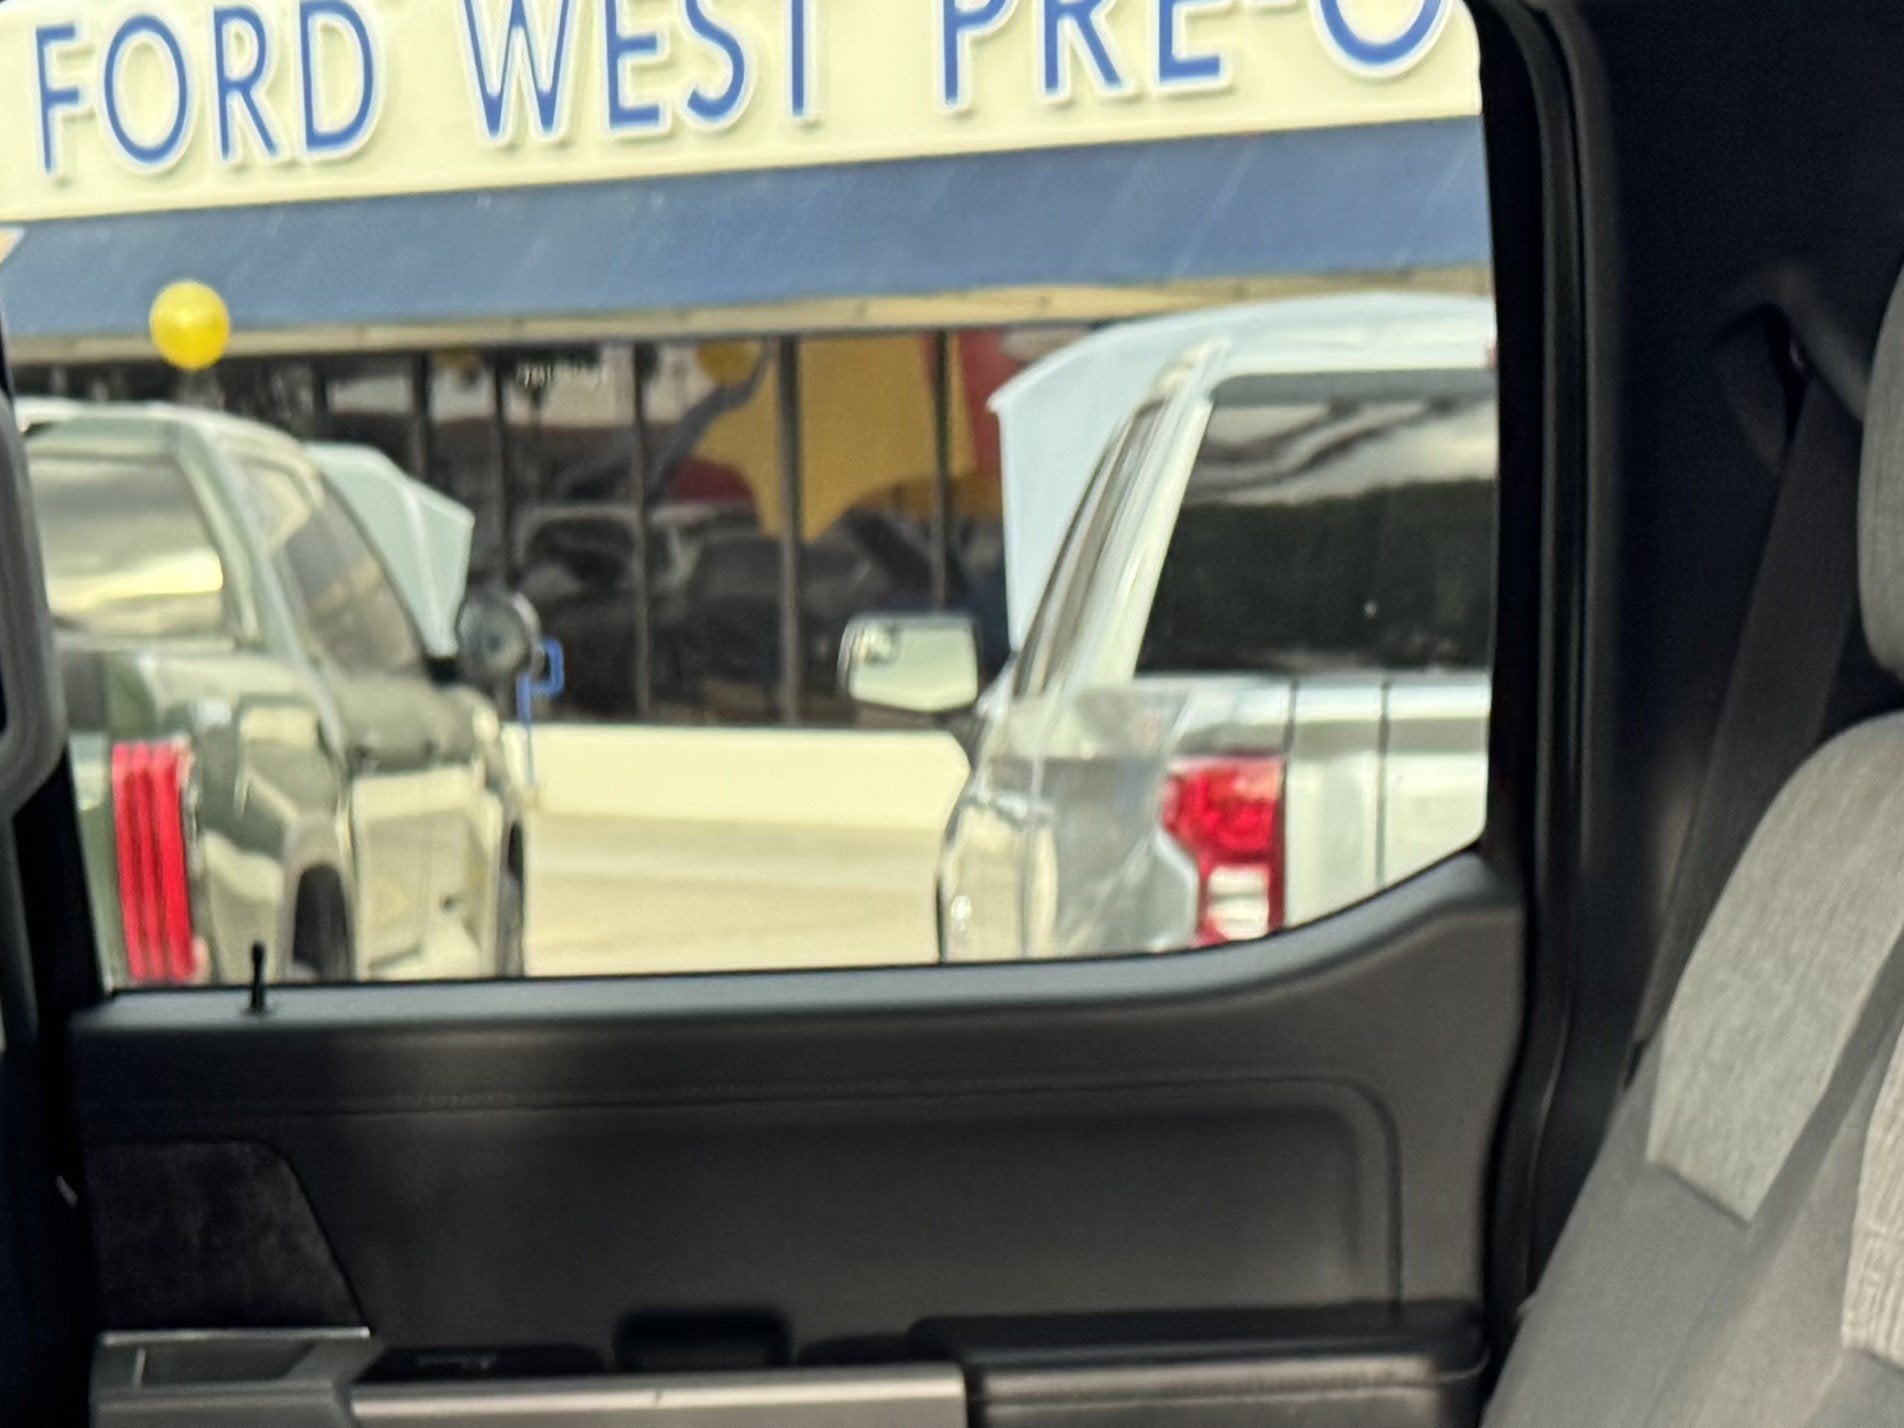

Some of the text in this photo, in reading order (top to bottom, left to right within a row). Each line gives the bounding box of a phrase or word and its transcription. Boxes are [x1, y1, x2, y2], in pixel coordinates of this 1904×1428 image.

[35, 0, 1445, 174] FORD WEST PRE
